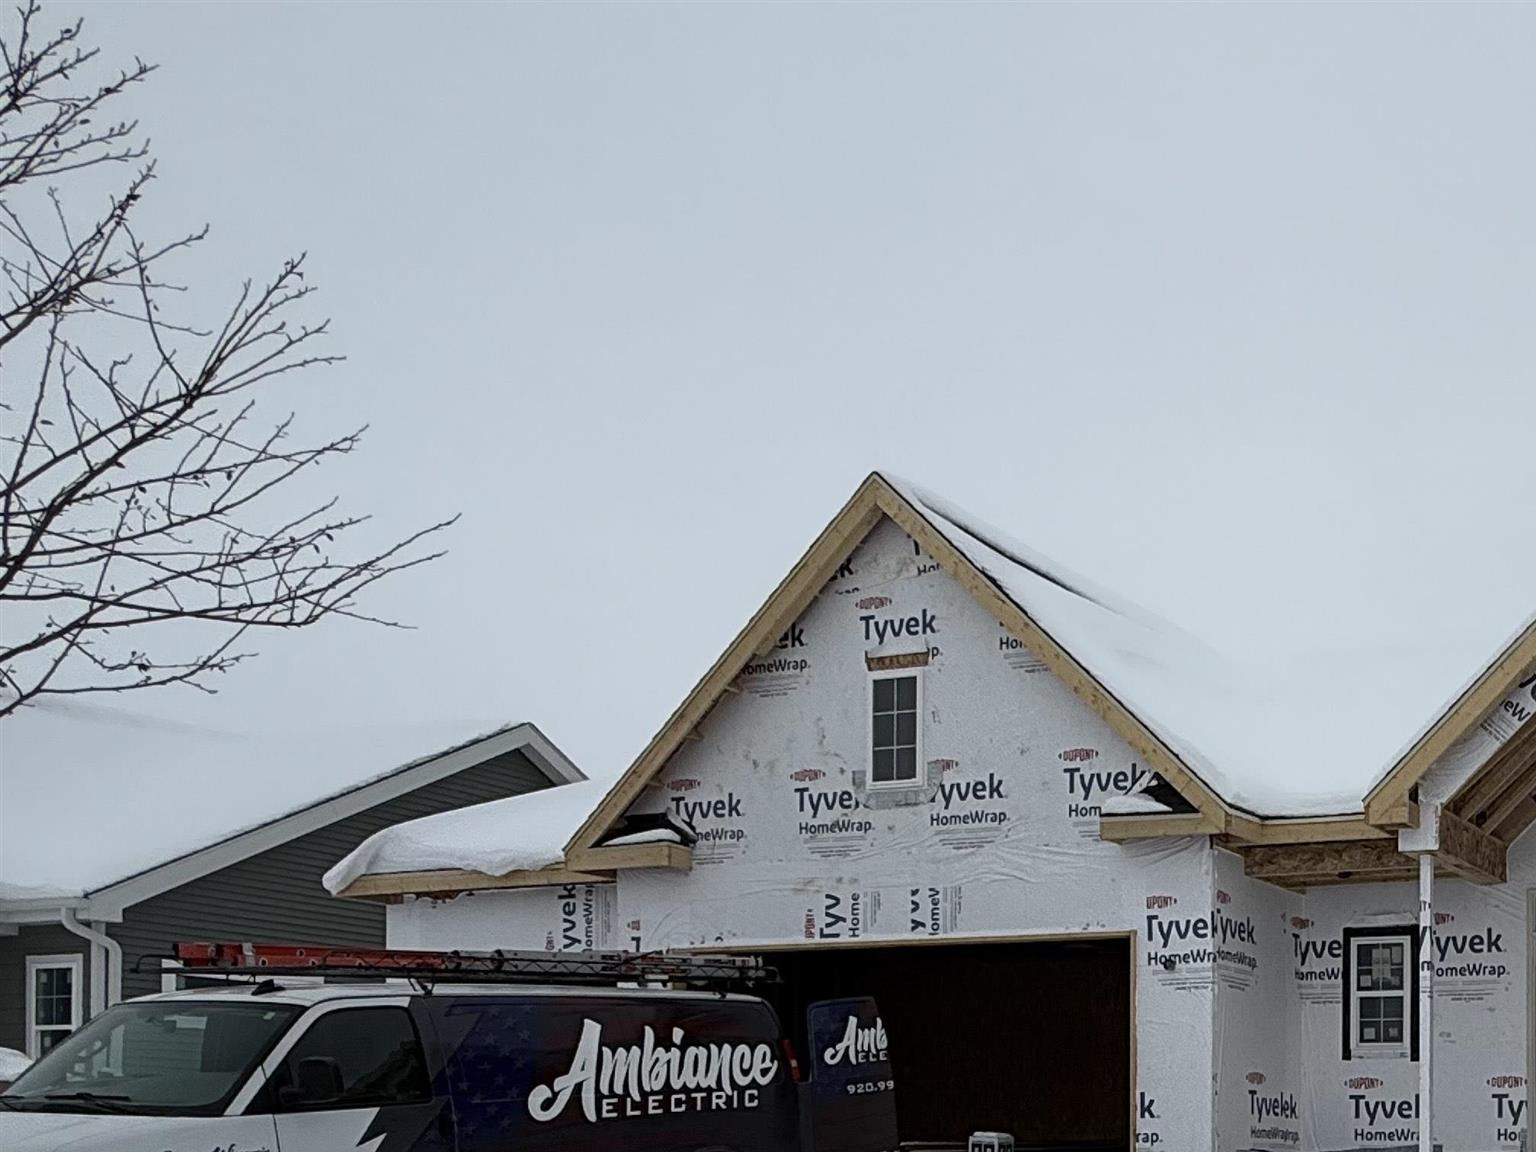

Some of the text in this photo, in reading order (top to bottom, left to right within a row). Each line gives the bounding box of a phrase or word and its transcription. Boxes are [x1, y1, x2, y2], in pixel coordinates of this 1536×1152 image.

[859, 608, 936, 645] Tyvek
[931, 773, 1004, 809] yvek
[671, 793, 742, 824] Tyvek
[930, 810, 1007, 826] HomeWrap
[799, 819, 872, 835] HomeWrap
[1216, 908, 1256, 944] yvek
[1433, 927, 1503, 962] yvek
[528, 1018, 778, 1123] Ambiance
[602, 1090, 759, 1118] ELECTRIC
[1492, 1093, 1528, 1126] Ty
